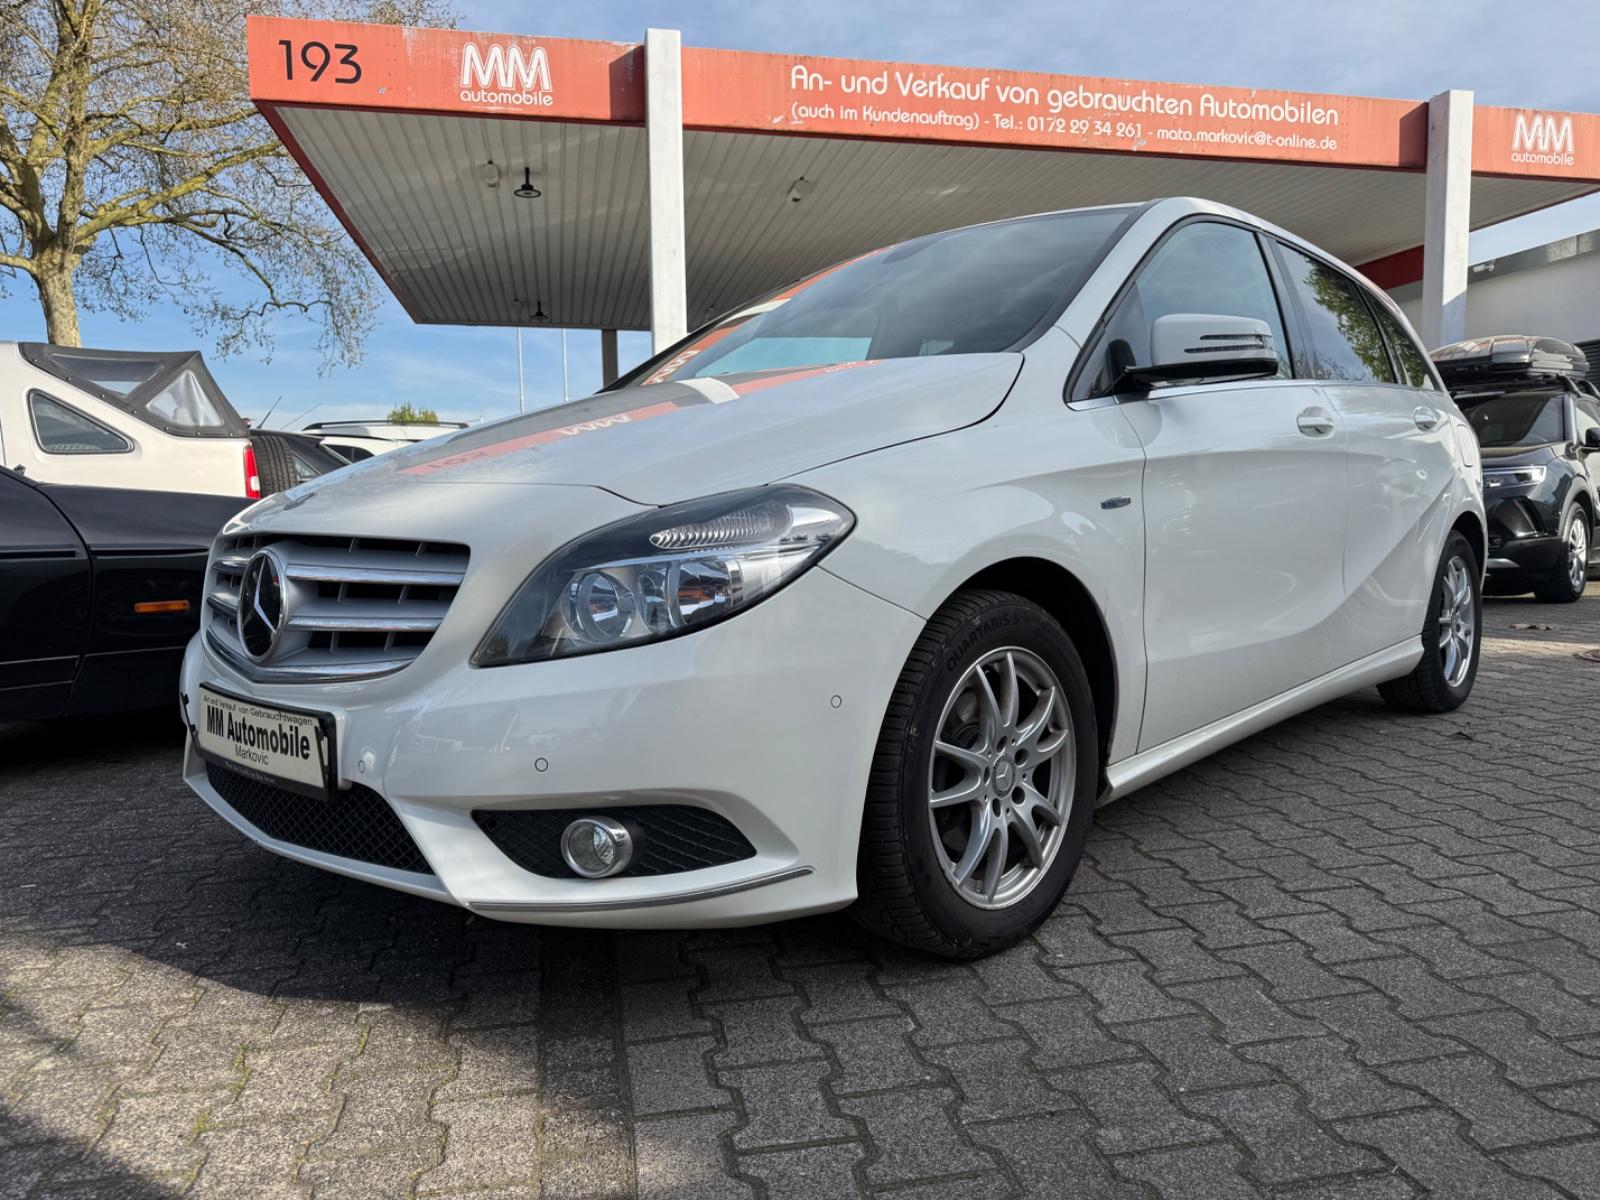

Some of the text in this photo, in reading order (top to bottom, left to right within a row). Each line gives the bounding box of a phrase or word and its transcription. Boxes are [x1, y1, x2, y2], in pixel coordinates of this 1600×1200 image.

[278, 39, 362, 85] 193
[460, 42, 553, 92] MM
[460, 90, 554, 106] automobile
[791, 64, 1338, 126] An- und Verkauf von gebrauchten Automobilen
[791, 101, 834, 120] (auch
[840, 105, 858, 121] im
[863, 106, 980, 131] Kundenauftrag)
[993, 113, 1023, 131] Tel.:
[1027, 115, 1066, 133] 0172
[1070, 119, 1089, 134] 29
[1093, 120, 1112, 136] 34
[1116, 122, 1142, 138] 261
[1157, 128, 1337, 150] mato.markovic@t-online.de
[1512, 113, 1574, 154] MM
[1511, 152, 1574, 165] automobile
[206, 704, 310, 760] MM Automobile
[250, 707, 314, 727] Gebrauchtwagen
[234, 744, 269, 766] Markovic
